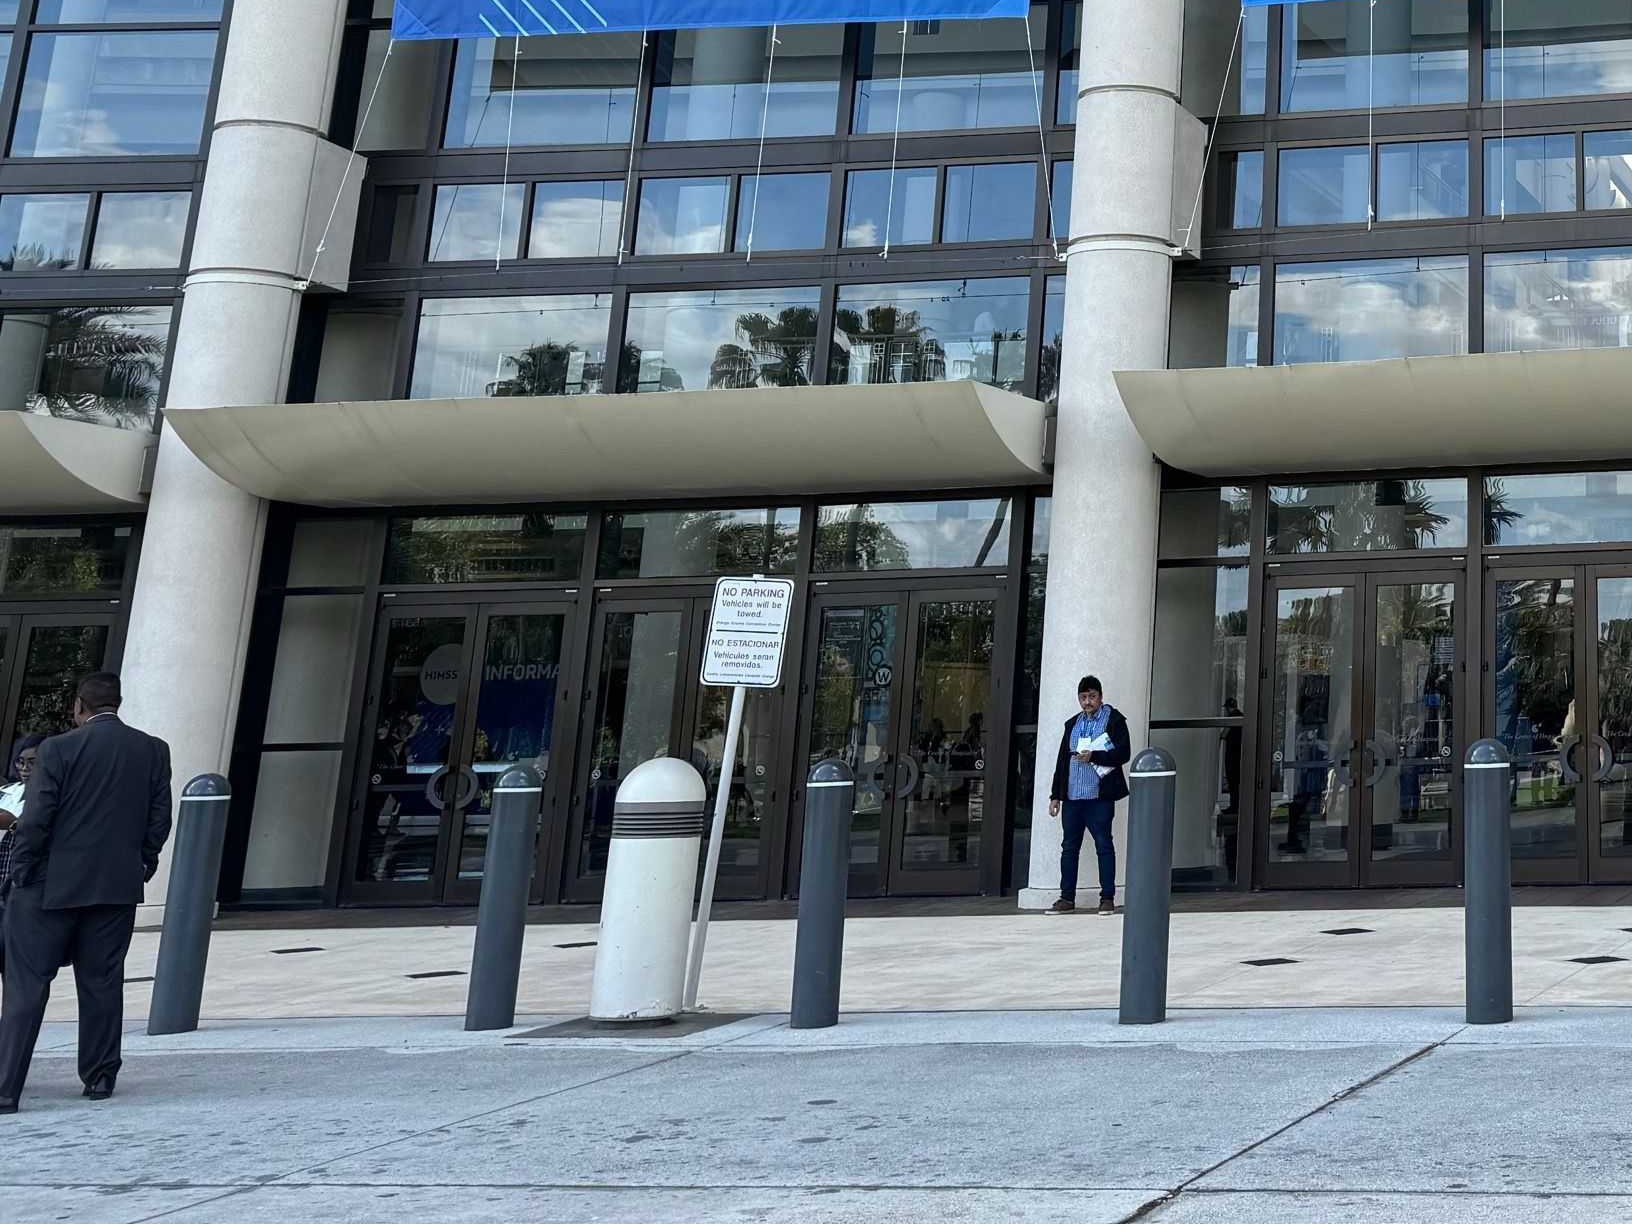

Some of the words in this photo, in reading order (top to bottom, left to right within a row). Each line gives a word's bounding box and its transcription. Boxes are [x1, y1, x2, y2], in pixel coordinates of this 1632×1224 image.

[722, 587, 737, 597] NO
[741, 588, 785, 598] PARKING
[722, 600, 753, 608] Vehicles
[756, 601, 770, 609] will
[771, 601, 782, 609] be
[737, 610, 763, 618] towed.
[711, 639, 724, 647] NO
[727, 640, 780, 649] ESTACIONAR
[721, 660, 763, 669] removidos.
[877, 671, 890, 684] W
